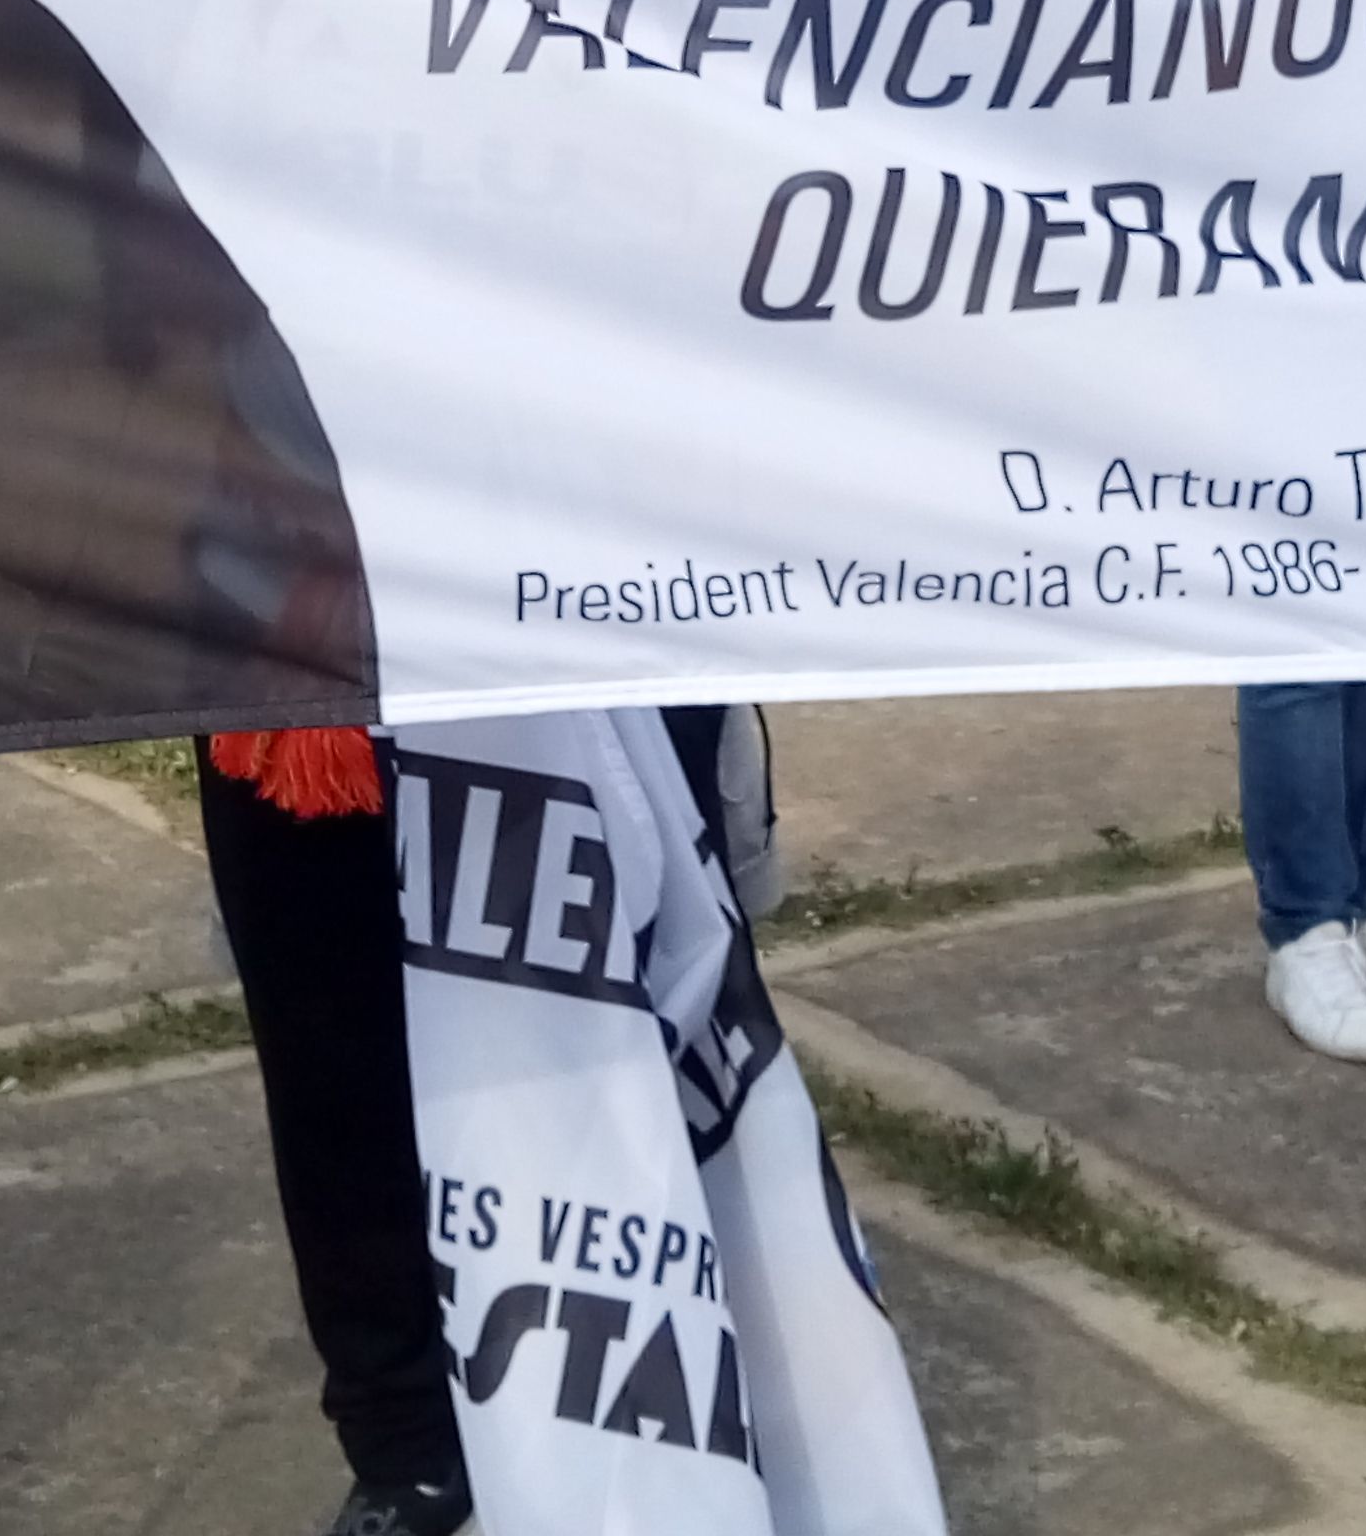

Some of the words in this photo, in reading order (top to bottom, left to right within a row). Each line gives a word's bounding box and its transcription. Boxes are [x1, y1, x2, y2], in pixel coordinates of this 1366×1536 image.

[999, 450, 1073, 513] D.
[1097, 457, 1314, 518] Arturo
[516, 559, 799, 624] President
[815, 550, 1070, 609] Valencia
[1094, 543, 1187, 605] C.F.
[423, 1170, 502, 1253] ES
